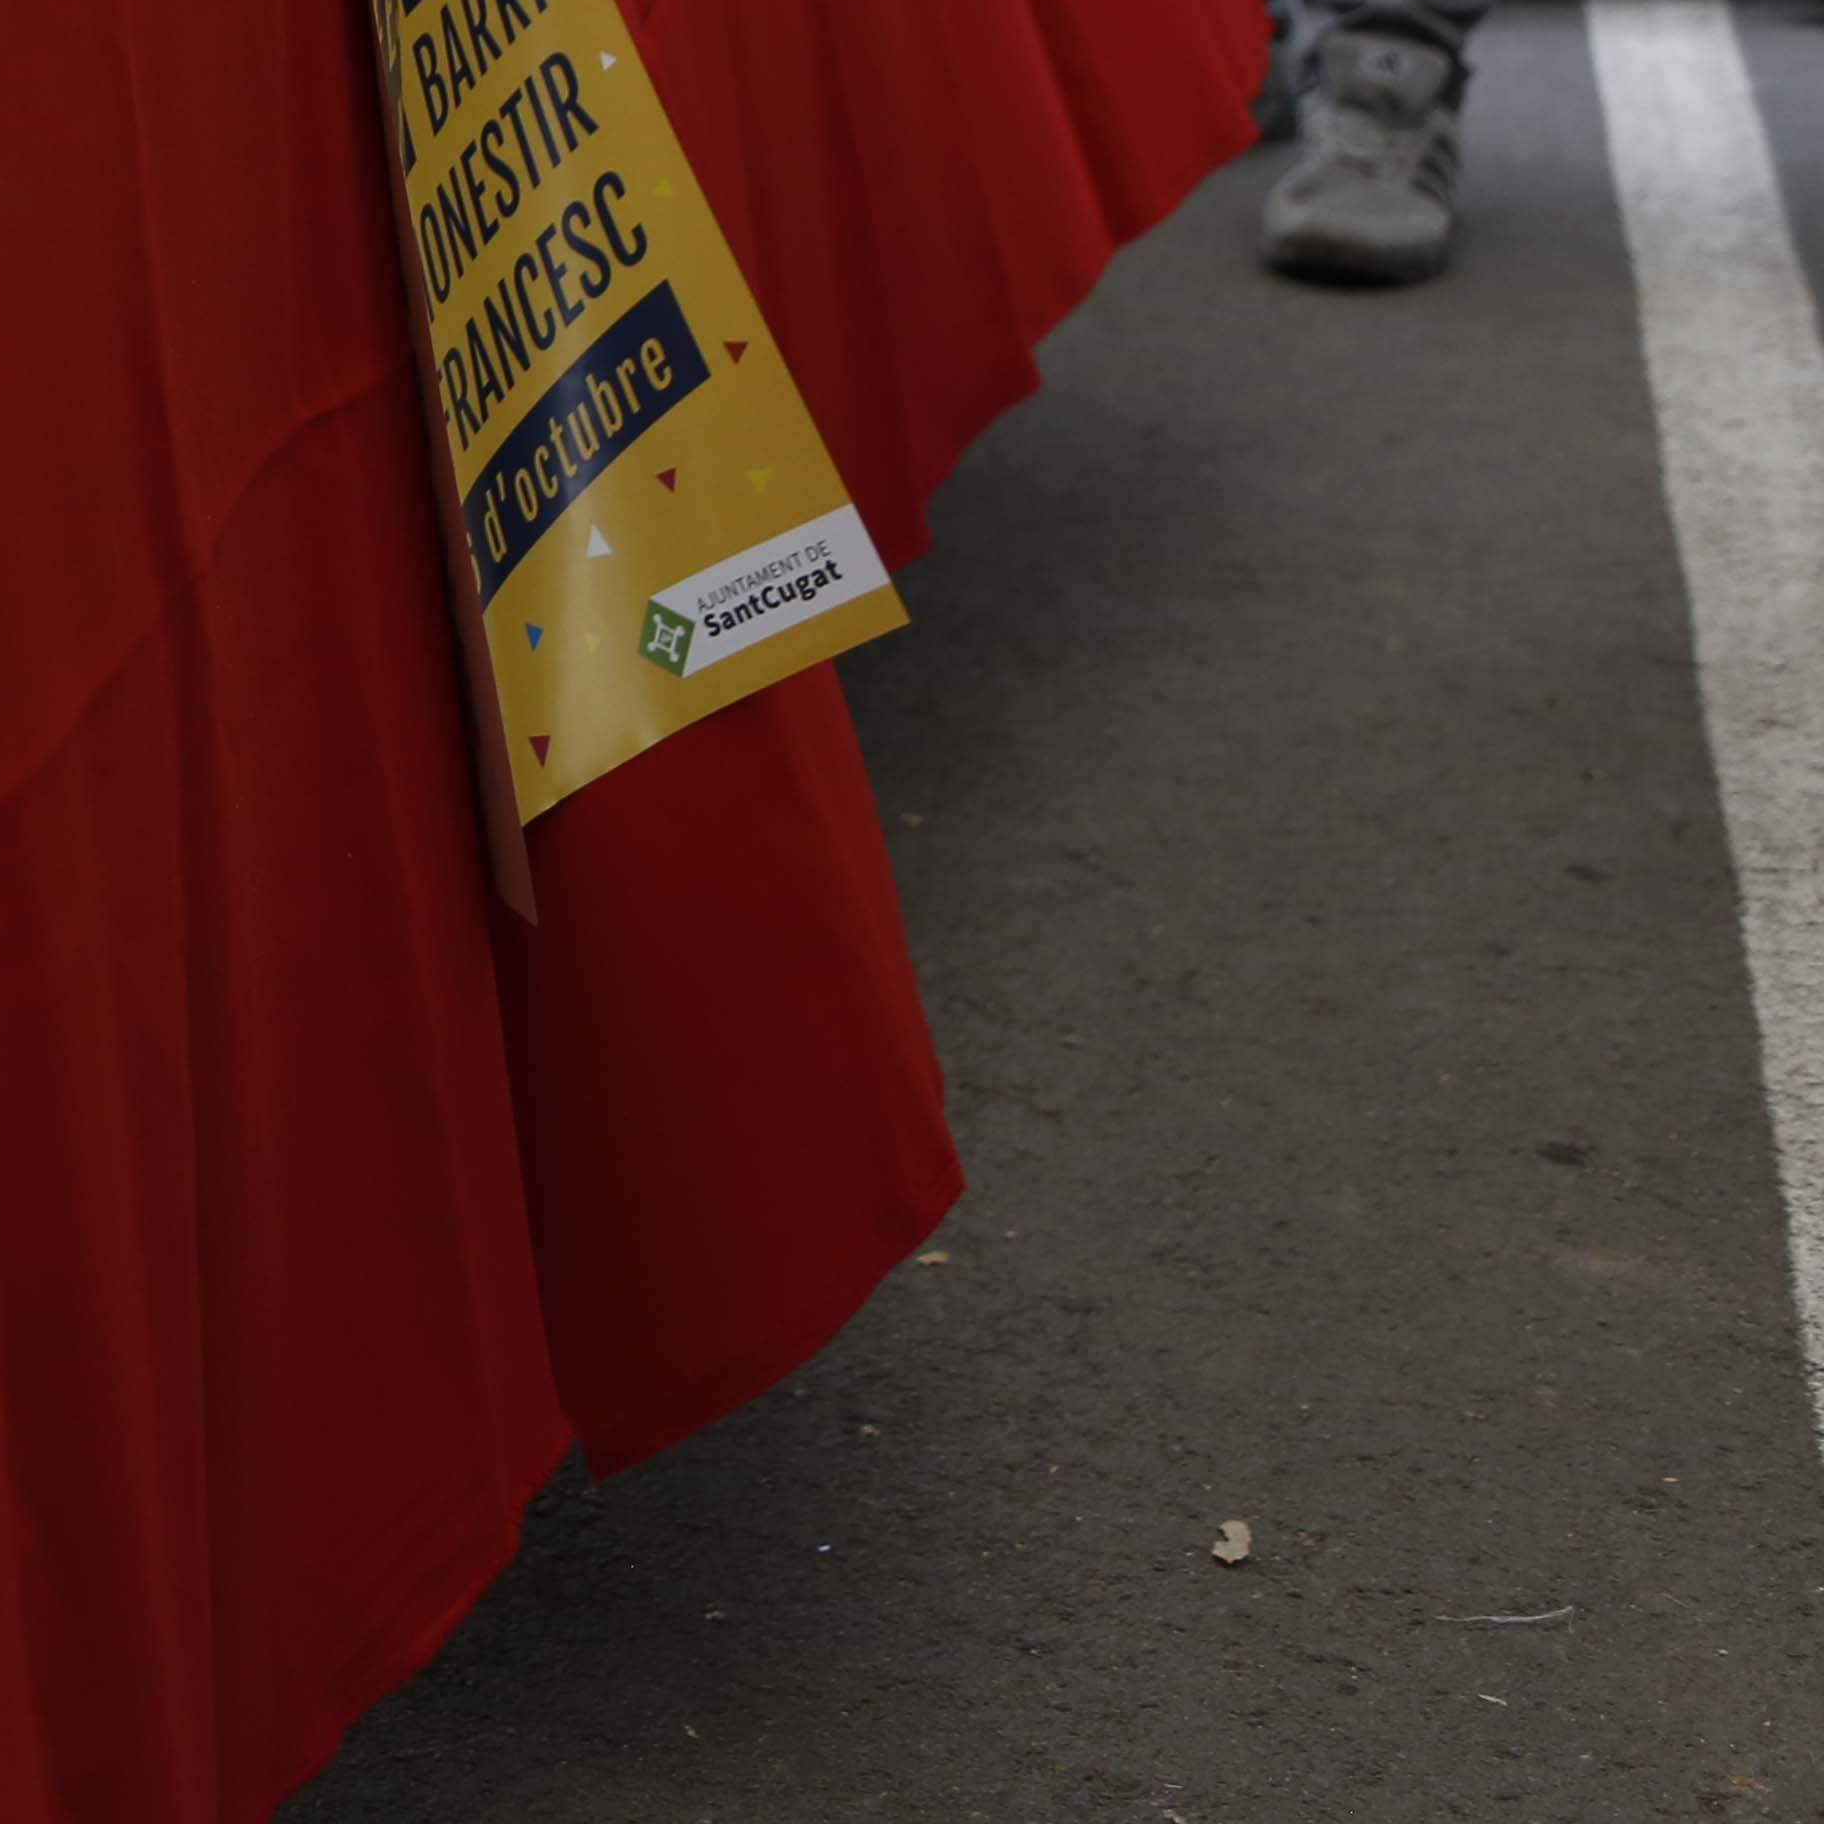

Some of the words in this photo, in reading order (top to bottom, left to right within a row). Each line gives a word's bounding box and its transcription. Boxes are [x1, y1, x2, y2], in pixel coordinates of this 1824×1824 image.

[419, 51, 599, 323] ONESTIR
[483, 336, 673, 564] d'octubre
[697, 551, 803, 612] AJUNTAMENT
[804, 539, 831, 563] DE
[704, 560, 843, 637] SantCugat
